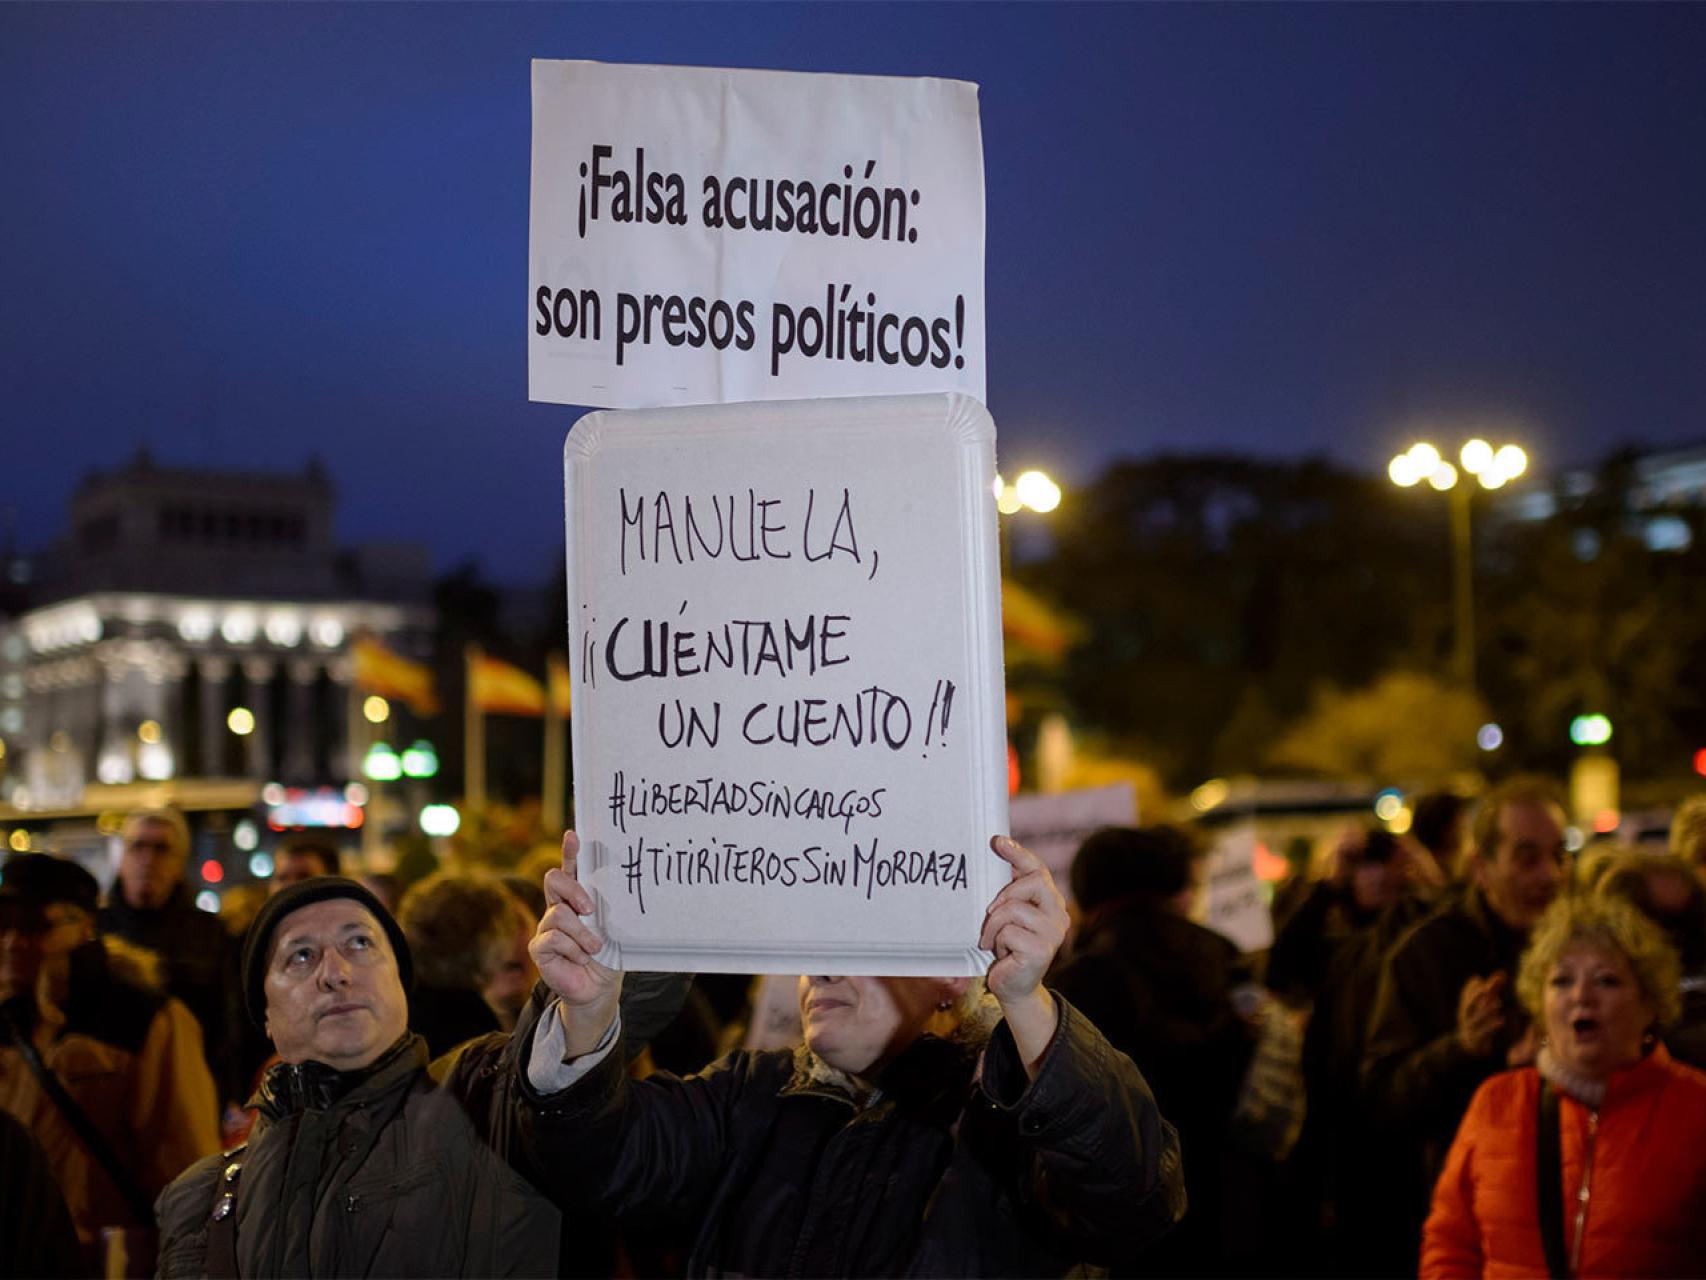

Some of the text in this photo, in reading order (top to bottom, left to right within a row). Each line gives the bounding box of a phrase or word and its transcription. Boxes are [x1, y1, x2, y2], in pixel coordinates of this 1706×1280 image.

[577, 143, 921, 245] ¡Falsa acusación:
[536, 283, 966, 377] son presos políticos!
[619, 487, 879, 581] MANUELA,
[658, 698, 721, 749] UN
